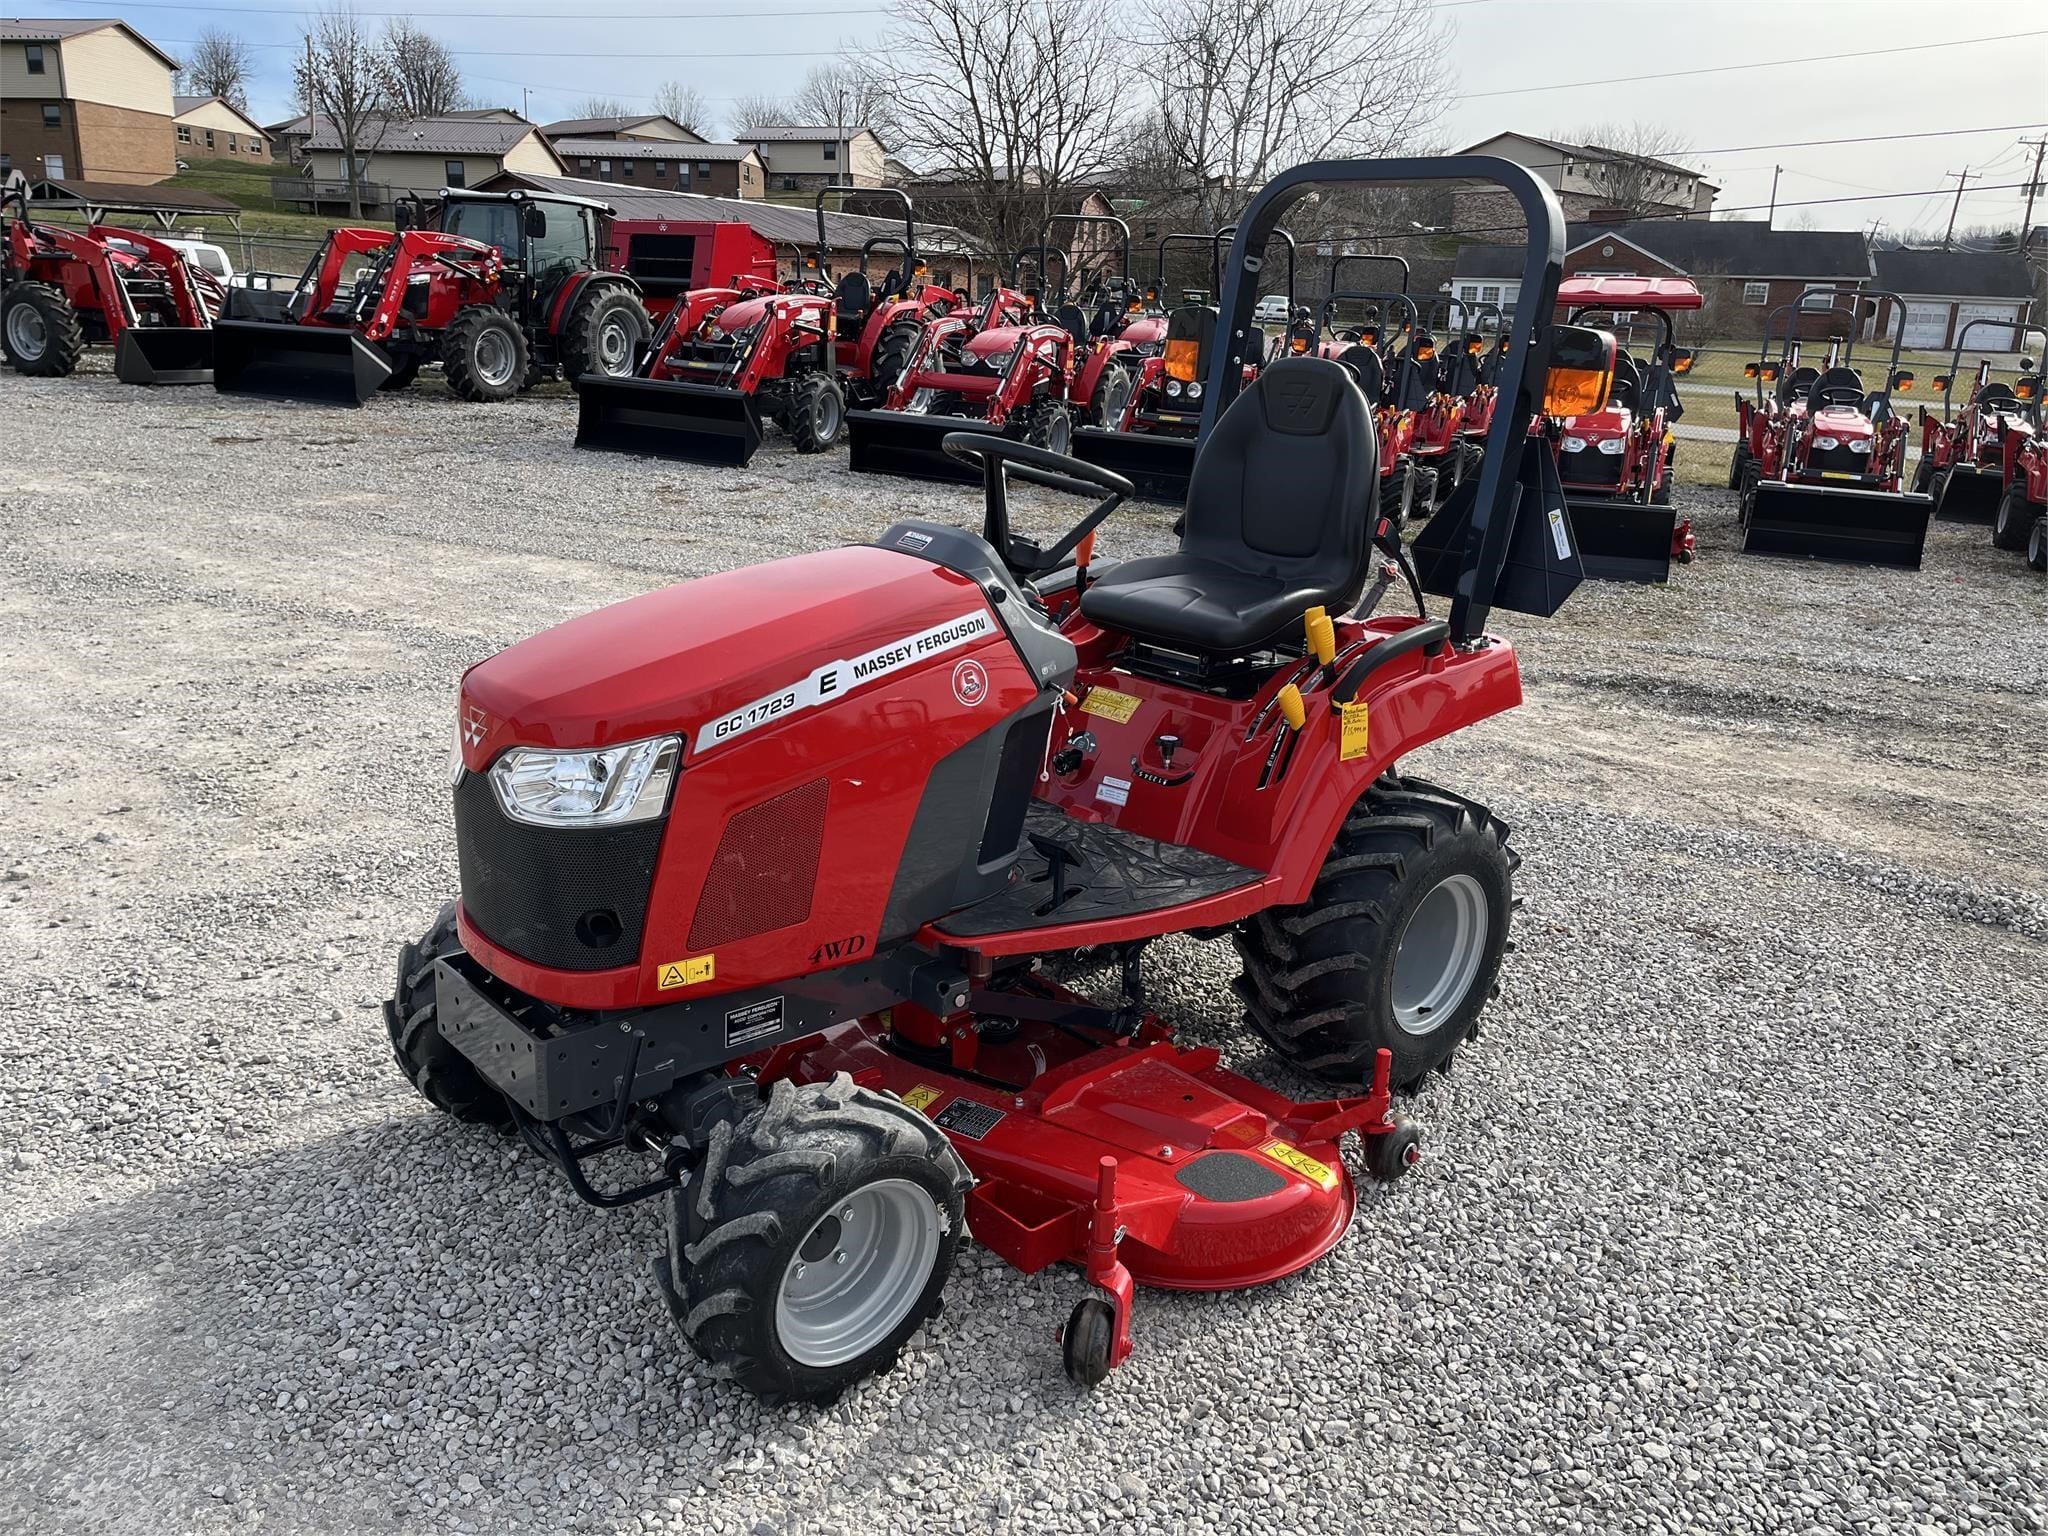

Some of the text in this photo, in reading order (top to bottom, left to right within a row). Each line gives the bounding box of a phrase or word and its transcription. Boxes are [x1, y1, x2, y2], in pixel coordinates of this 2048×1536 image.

[715, 617, 986, 738] GC 1723 E MASSEY FERGUSON
[808, 935, 865, 964] 4WD
